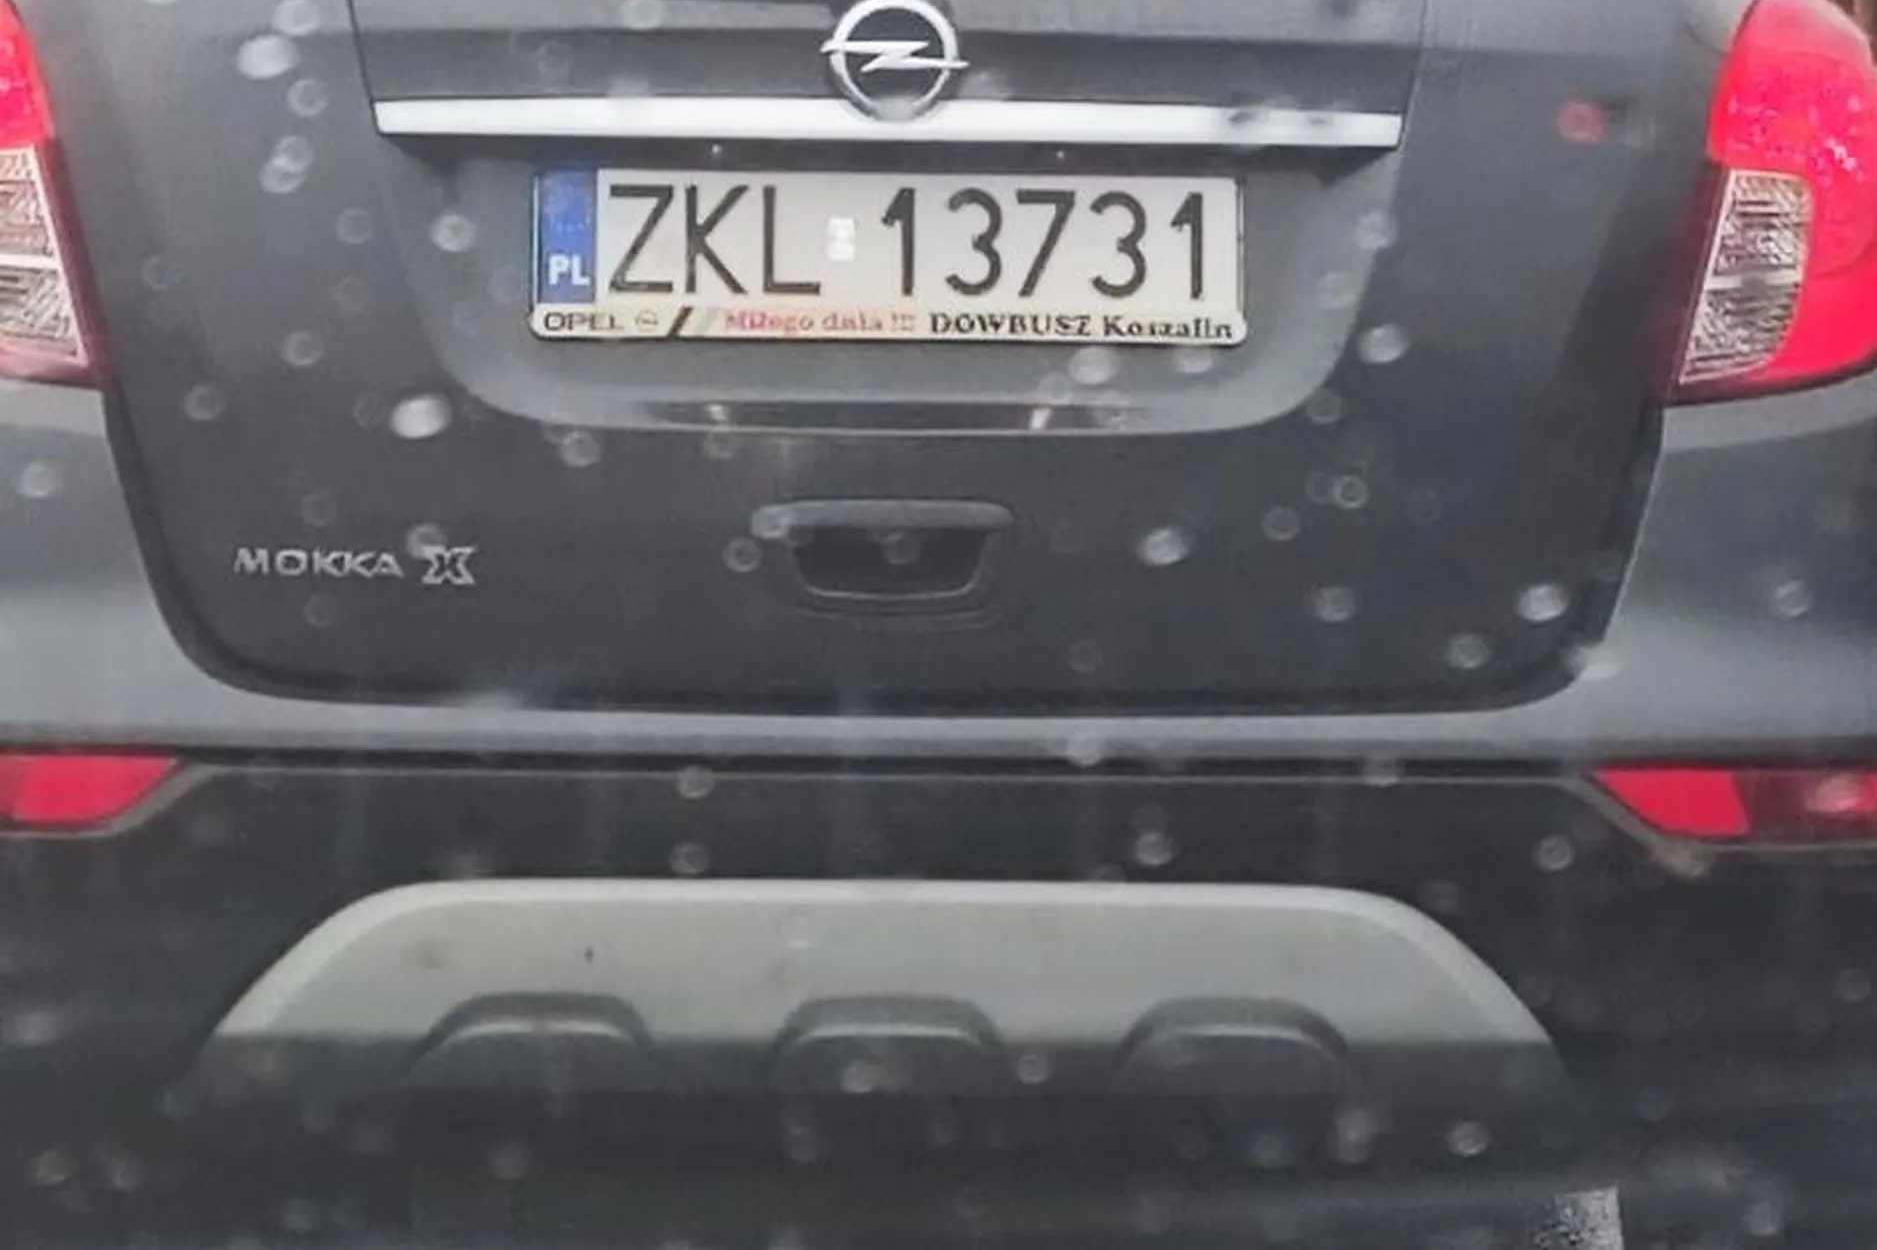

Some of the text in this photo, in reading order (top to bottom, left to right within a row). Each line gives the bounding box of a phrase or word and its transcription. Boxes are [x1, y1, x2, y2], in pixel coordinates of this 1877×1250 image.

[607, 184, 1206, 301] ZKL 13731
[548, 255, 590, 286] PL
[542, 311, 624, 332] OPEL
[822, 310, 884, 332] dnia
[928, 311, 1093, 338] DOWBUSZ
[1103, 314, 1234, 340] Koszalin
[233, 545, 477, 585] MOKKA X
